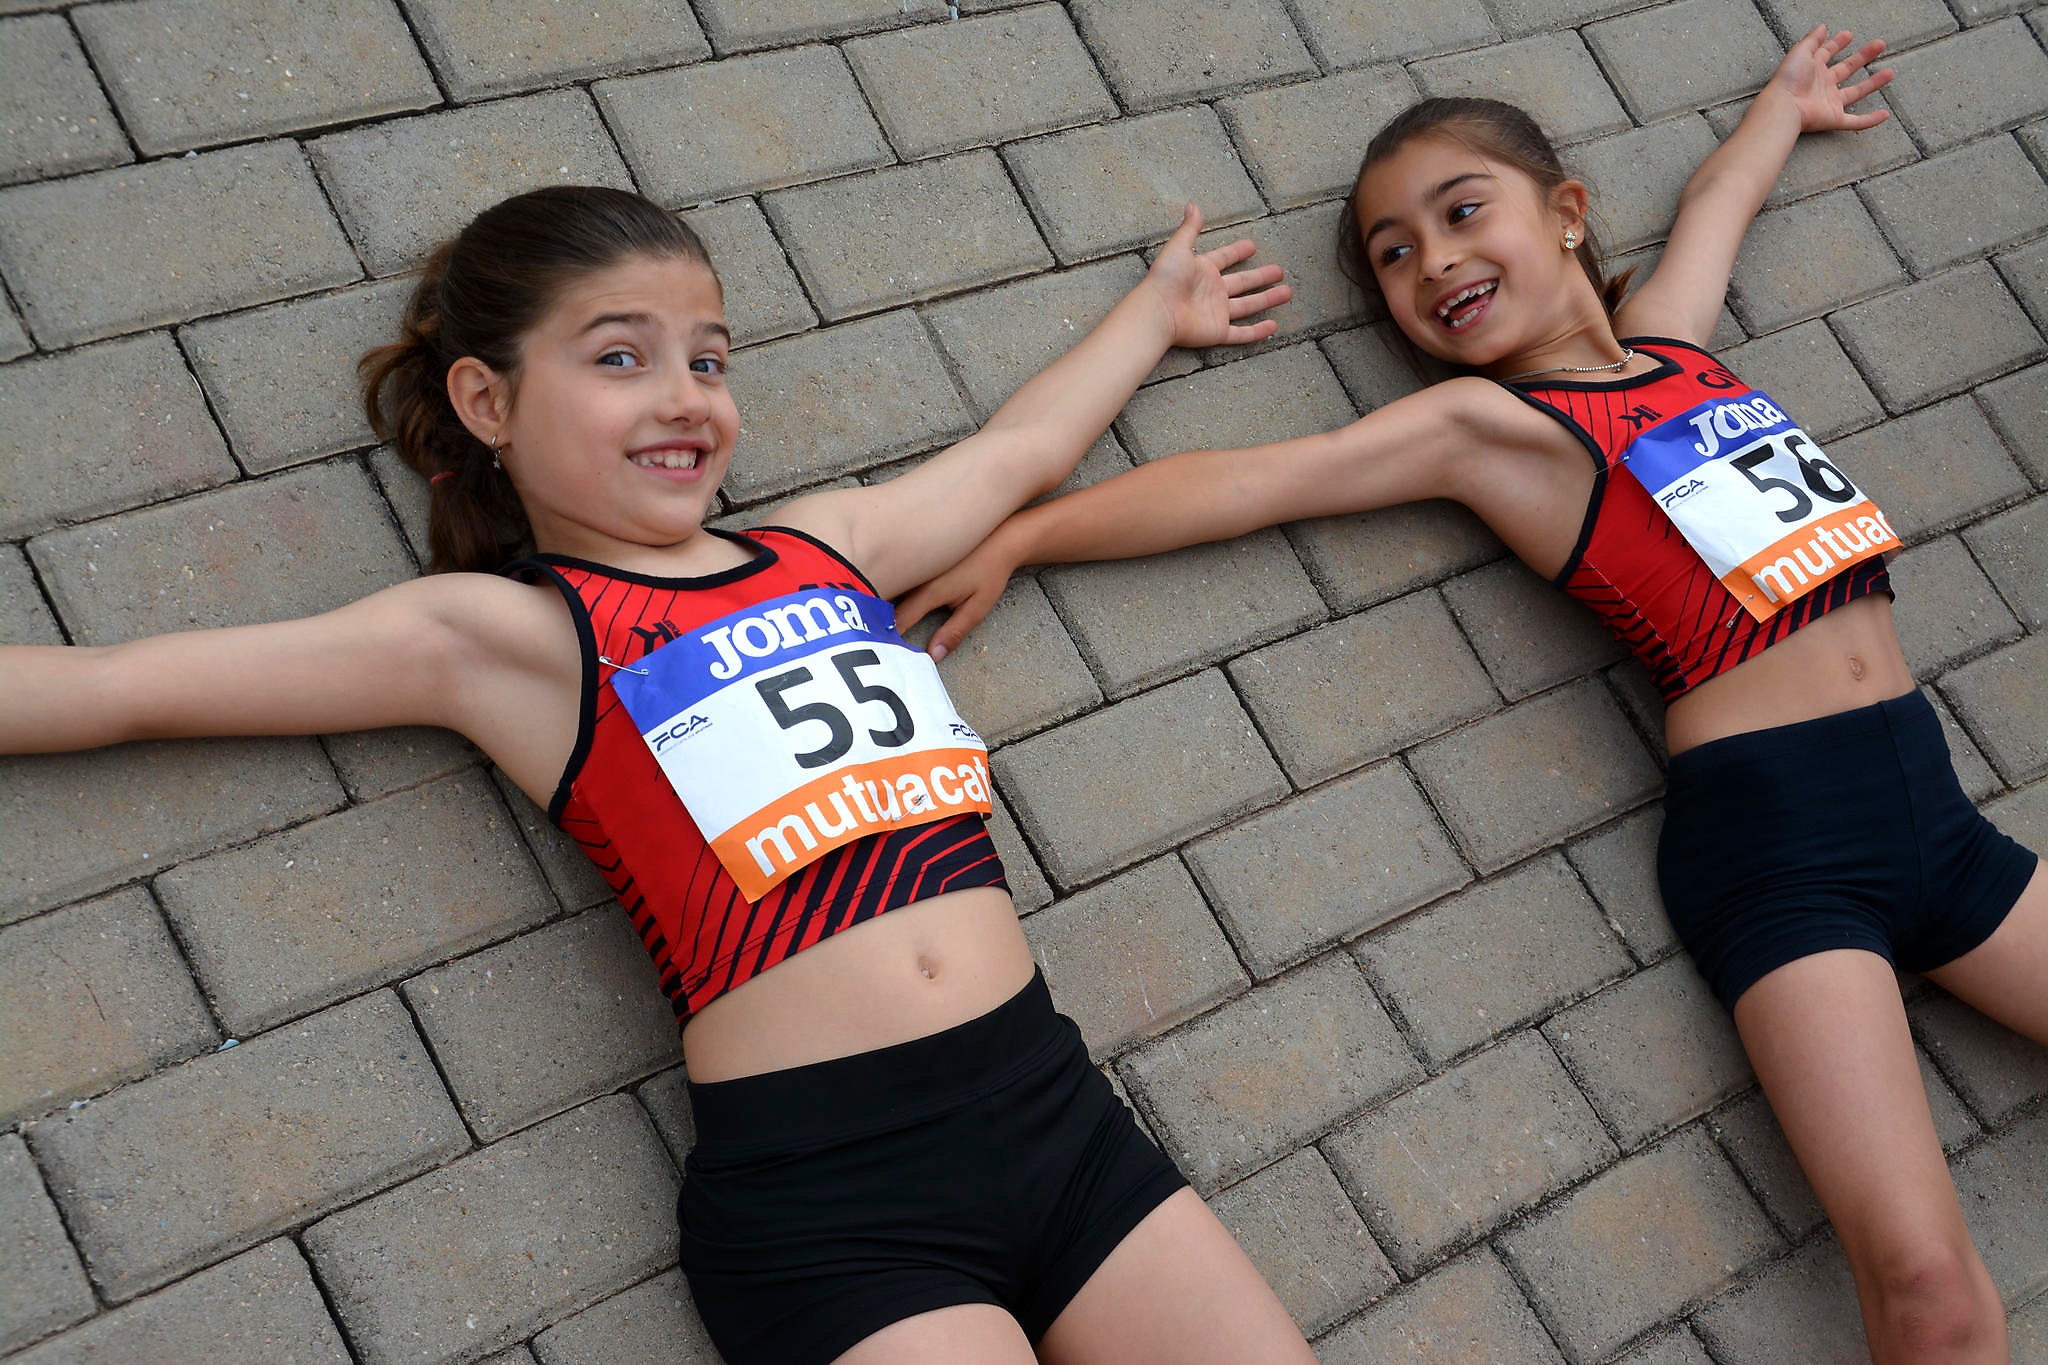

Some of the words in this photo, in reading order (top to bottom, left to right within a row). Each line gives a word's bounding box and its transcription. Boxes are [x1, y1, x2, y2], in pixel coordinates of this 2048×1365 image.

[1688, 397, 1788, 457] Joma
[1661, 479, 1705, 508] FCA
[1728, 434, 1857, 523] 56
[700, 595, 871, 680] Joma
[652, 714, 709, 752] FCA
[755, 649, 915, 769] 55
[744, 756, 993, 878] mutuacat
